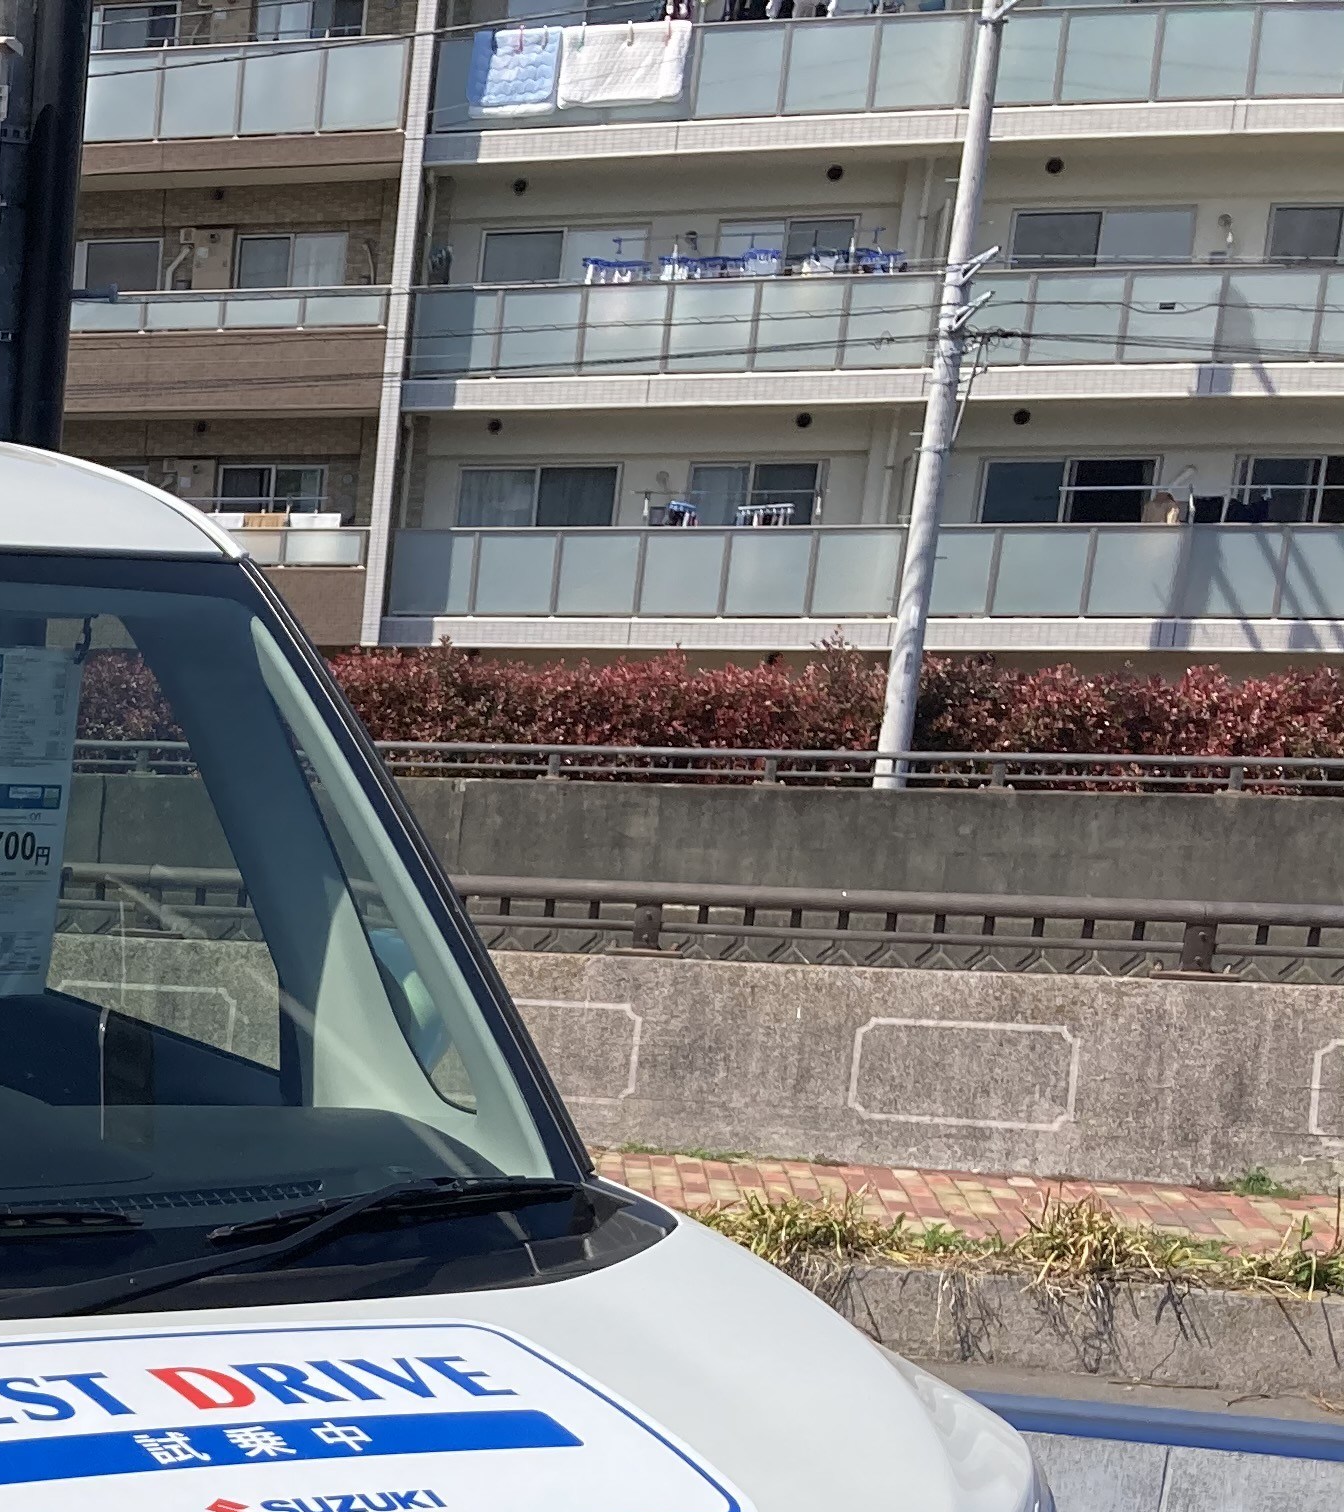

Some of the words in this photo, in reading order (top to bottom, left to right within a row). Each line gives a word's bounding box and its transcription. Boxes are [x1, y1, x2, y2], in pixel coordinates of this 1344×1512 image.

[145, 1355, 520, 1413] DRIVE
[132, 1419, 374, 1466] 試乗中
